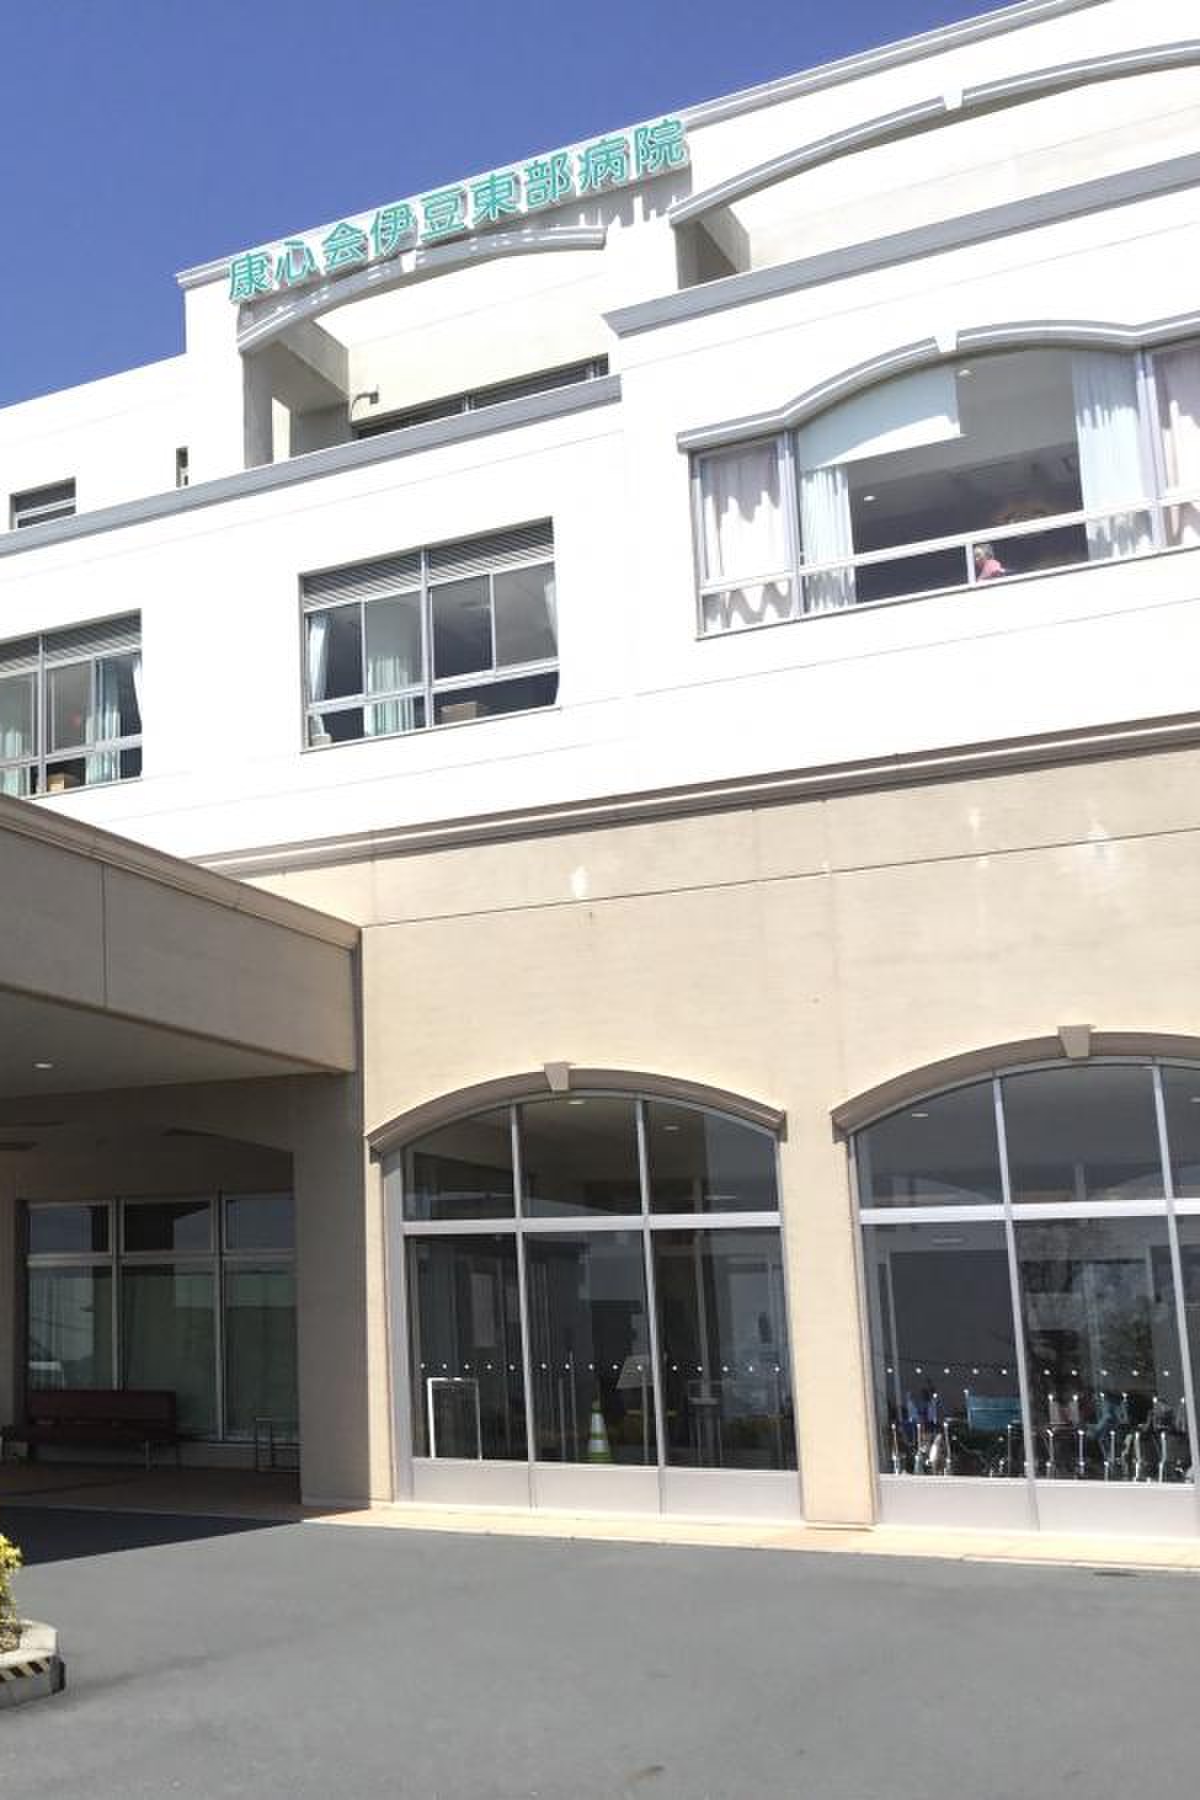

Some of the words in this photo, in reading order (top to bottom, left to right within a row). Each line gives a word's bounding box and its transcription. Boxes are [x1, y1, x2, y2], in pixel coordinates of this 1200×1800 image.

[229, 118, 688, 302] 康心会伊豆東部病院
